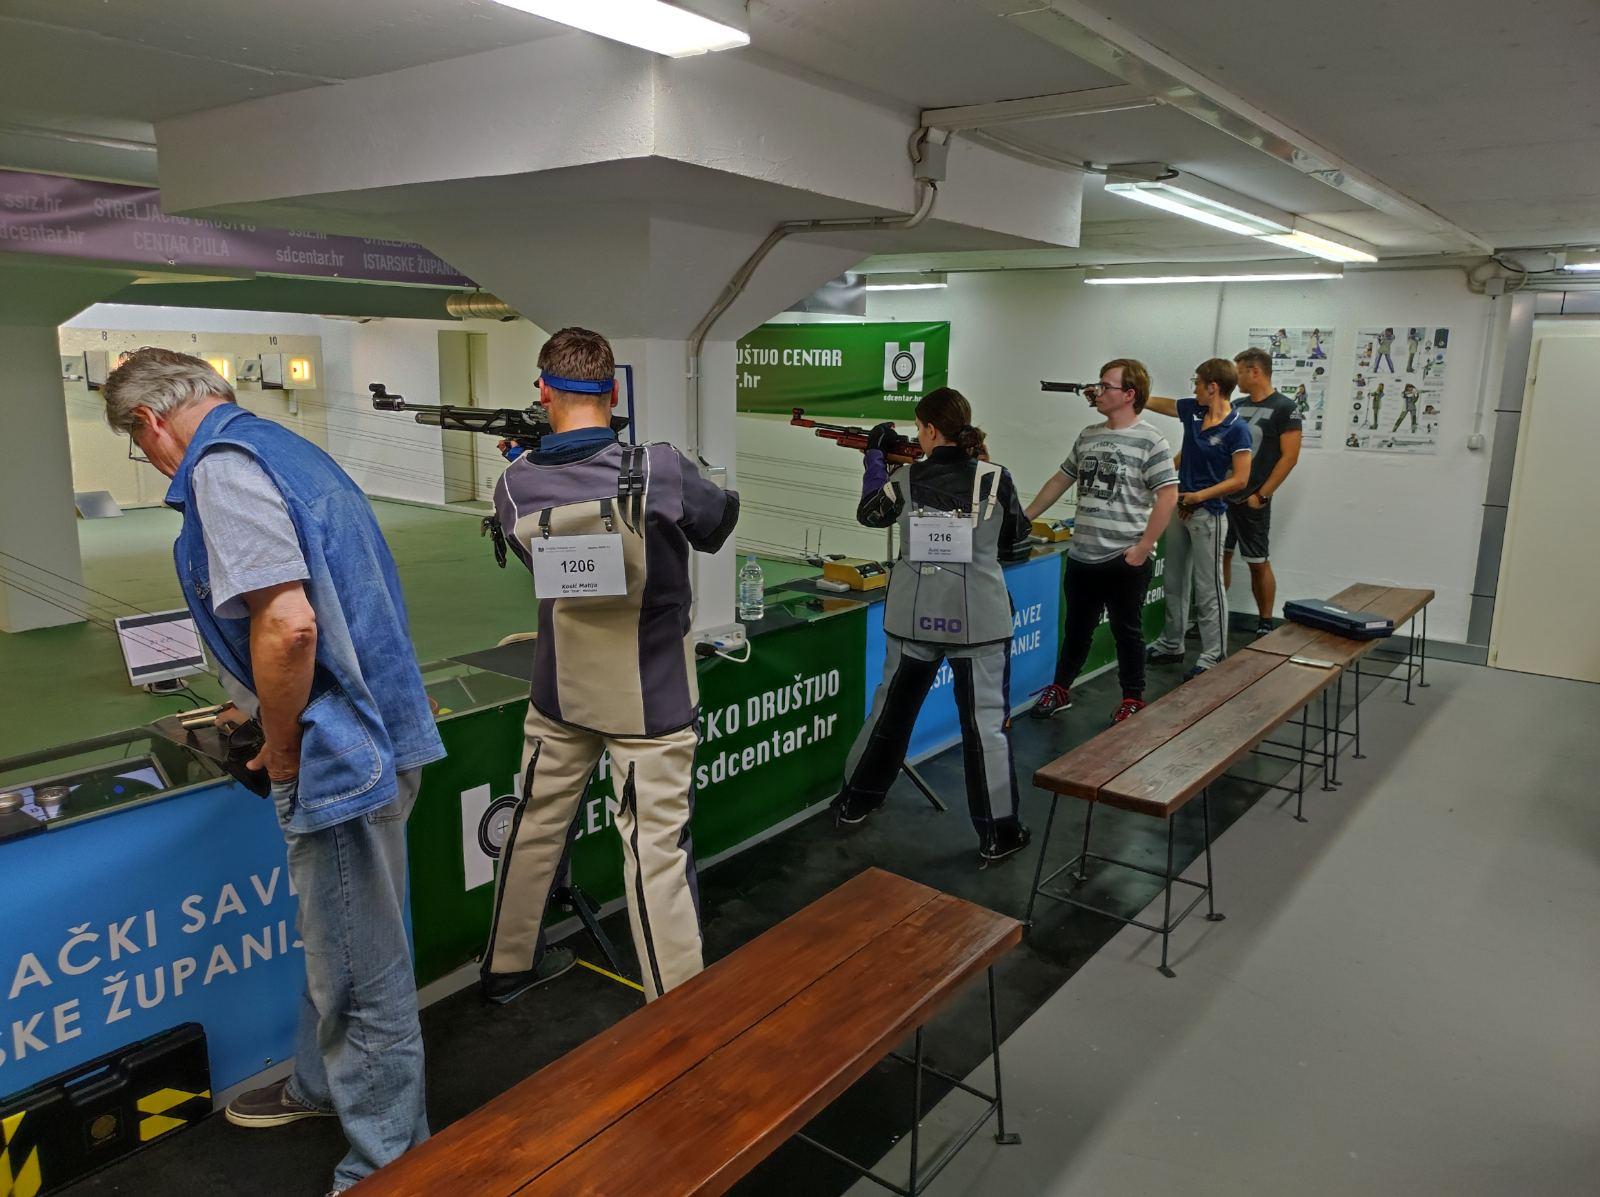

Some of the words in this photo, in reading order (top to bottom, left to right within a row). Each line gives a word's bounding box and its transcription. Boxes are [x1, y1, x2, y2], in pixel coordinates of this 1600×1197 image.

[133, 231, 190, 255] CENTAR
[192, 236, 230, 257] PULA
[275, 246, 345, 267] sdcentar.hr
[362, 252, 415, 272] ISTARSKE
[101, 330, 108, 341] 8
[191, 333, 197, 343] 9
[269, 335, 278, 346] 10
[783, 349, 842, 367] CENTAR
[928, 533, 952, 542] 1216
[561, 559, 595, 573] 1206
[919, 616, 962, 633] CRO
[1013, 603, 1041, 629] AVEZ
[1010, 630, 1041, 657] ANIJE
[696, 713, 837, 790] sdcentar.hr
[8, 909, 157, 1000] AČKI
